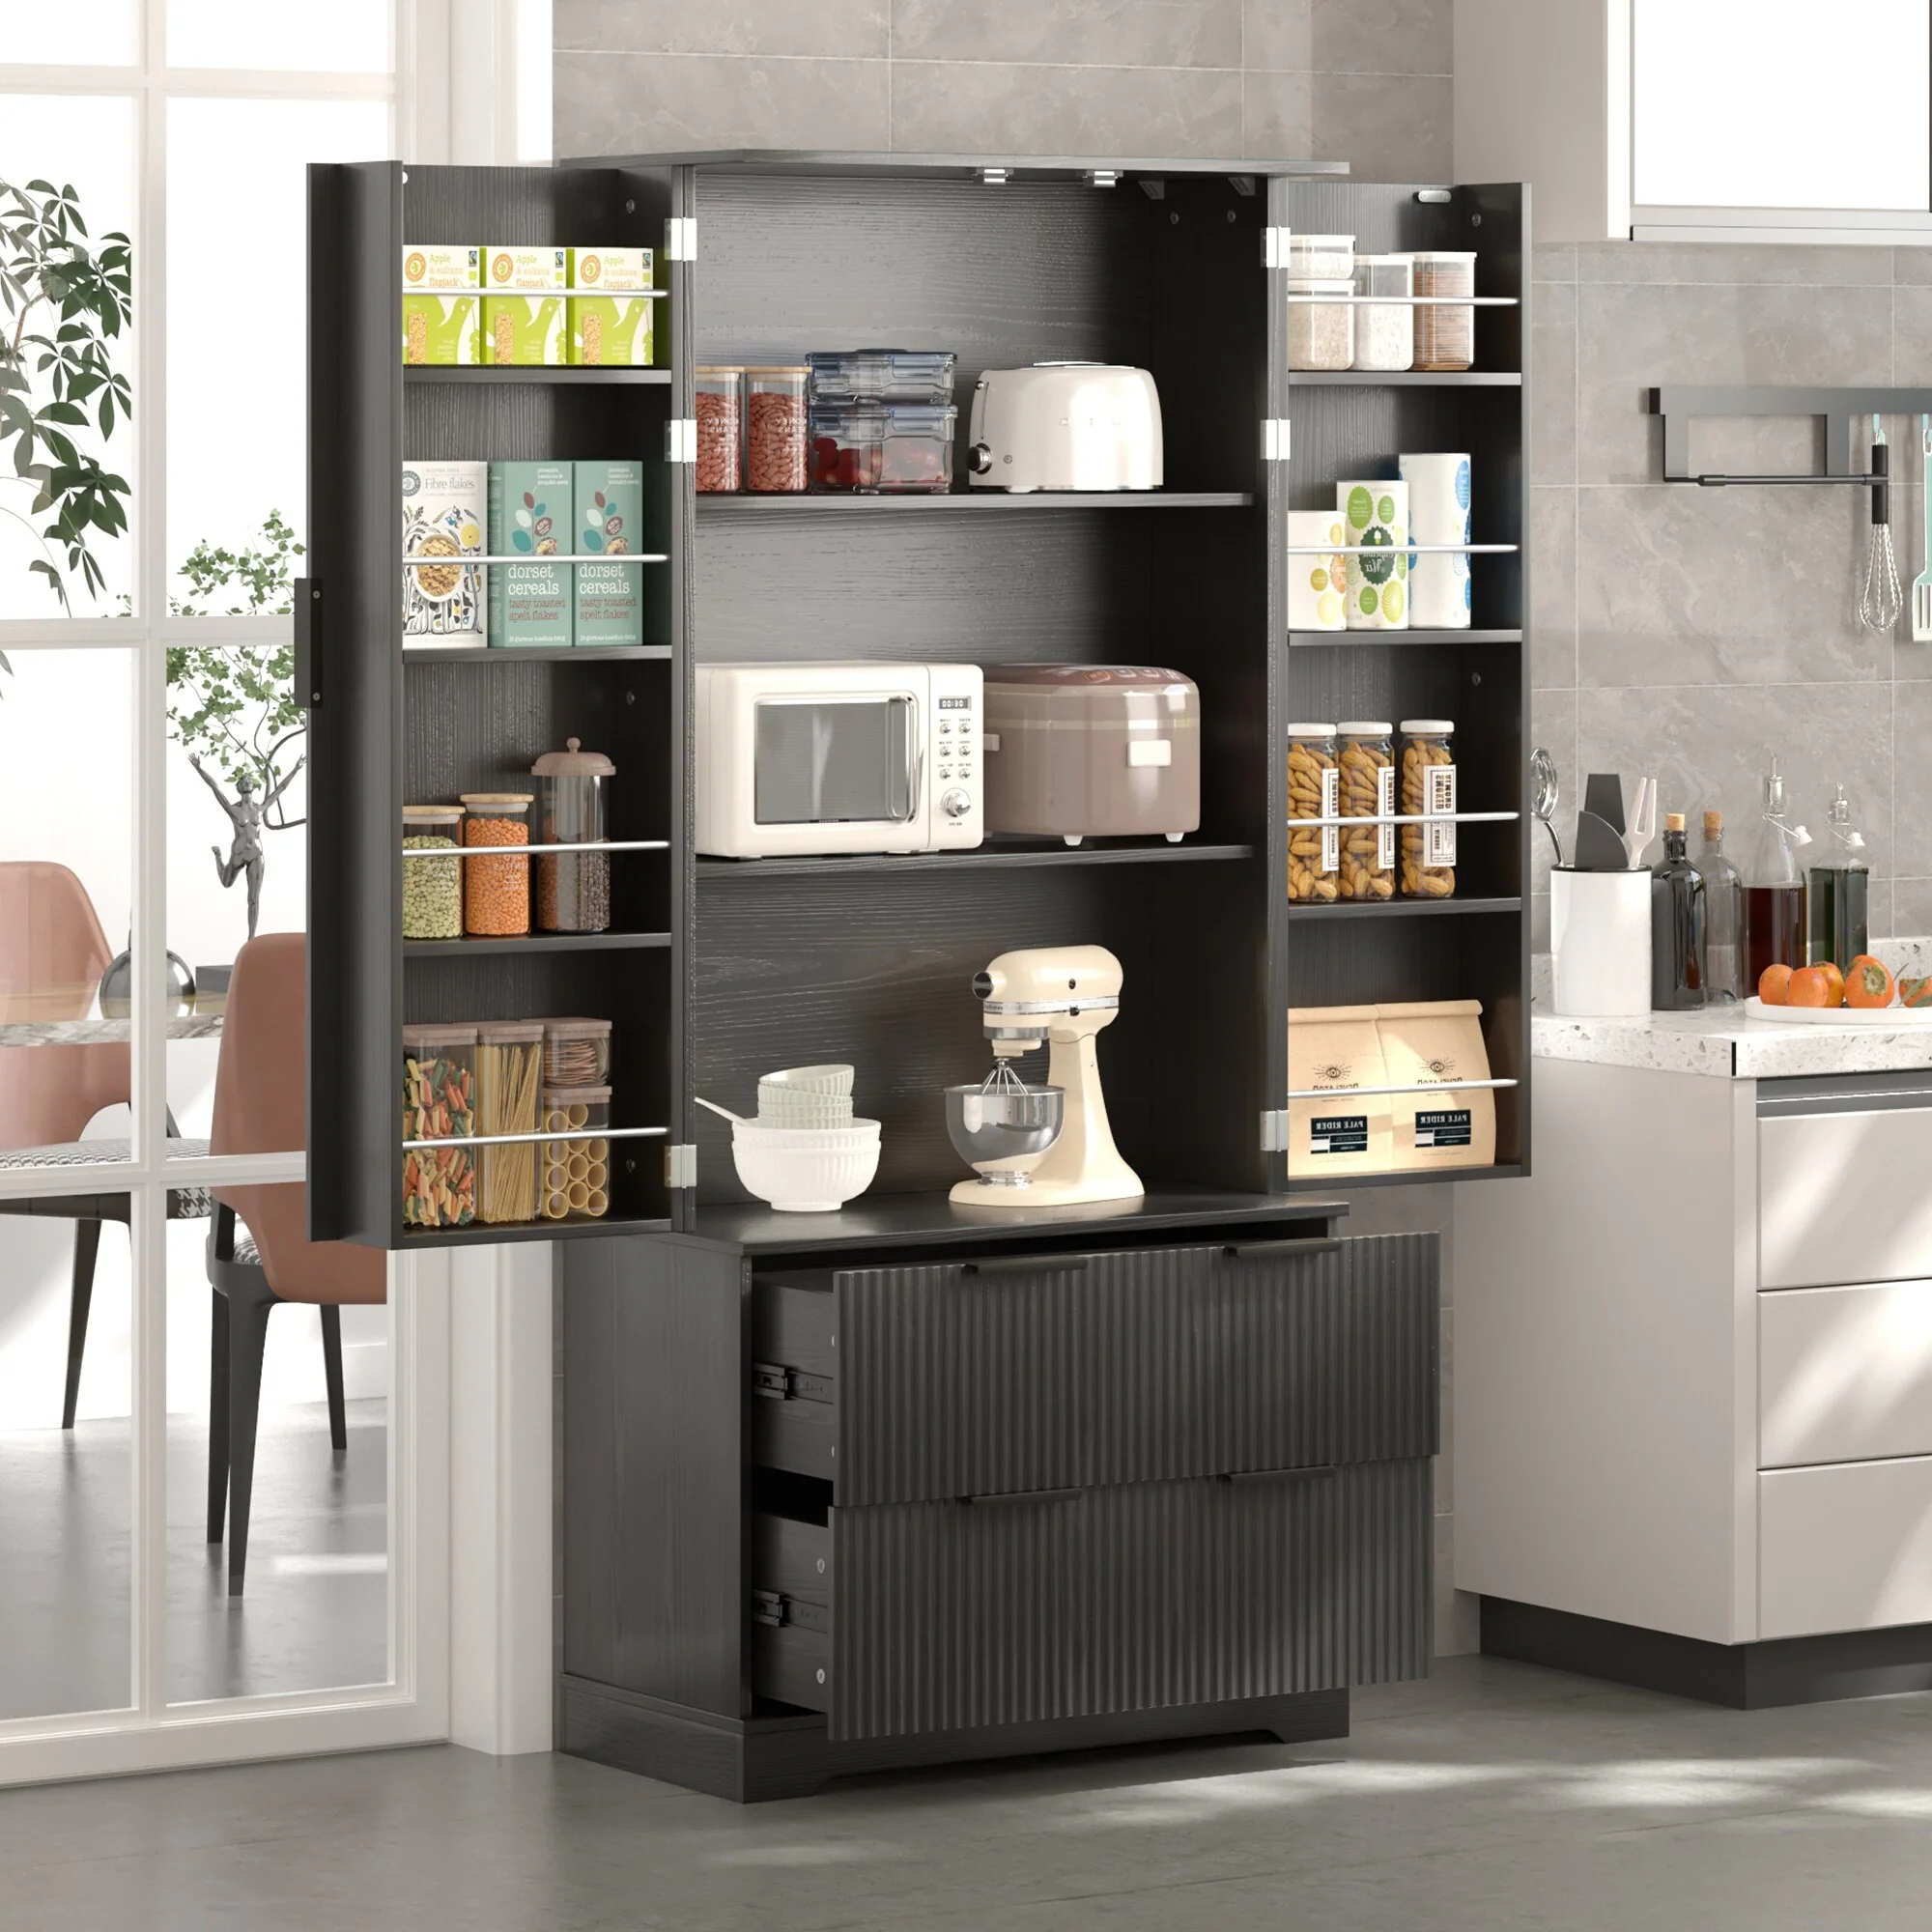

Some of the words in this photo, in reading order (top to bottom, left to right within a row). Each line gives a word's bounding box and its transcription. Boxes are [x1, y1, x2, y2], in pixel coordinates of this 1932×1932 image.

[429, 253, 451, 263] Apple
[516, 255, 537, 265] Apple
[604, 256, 625, 266] Apple
[425, 477, 447, 490] Fibre
[449, 477, 474, 490] flakes
[508, 564, 554, 579] dorset
[580, 563, 624, 578] dorset
[508, 581, 559, 595] cereals
[580, 580, 630, 594] cereals
[509, 598, 532, 610] tasty
[533, 598, 566, 608] toasted
[580, 598, 602, 609] tasty
[604, 597, 637, 607] toasted
[509, 611, 530, 623] spelt
[532, 611, 558, 620] flakes
[580, 611, 601, 621] spelt
[604, 610, 629, 619] flakes
[942, 699, 964, 708] 00:30
